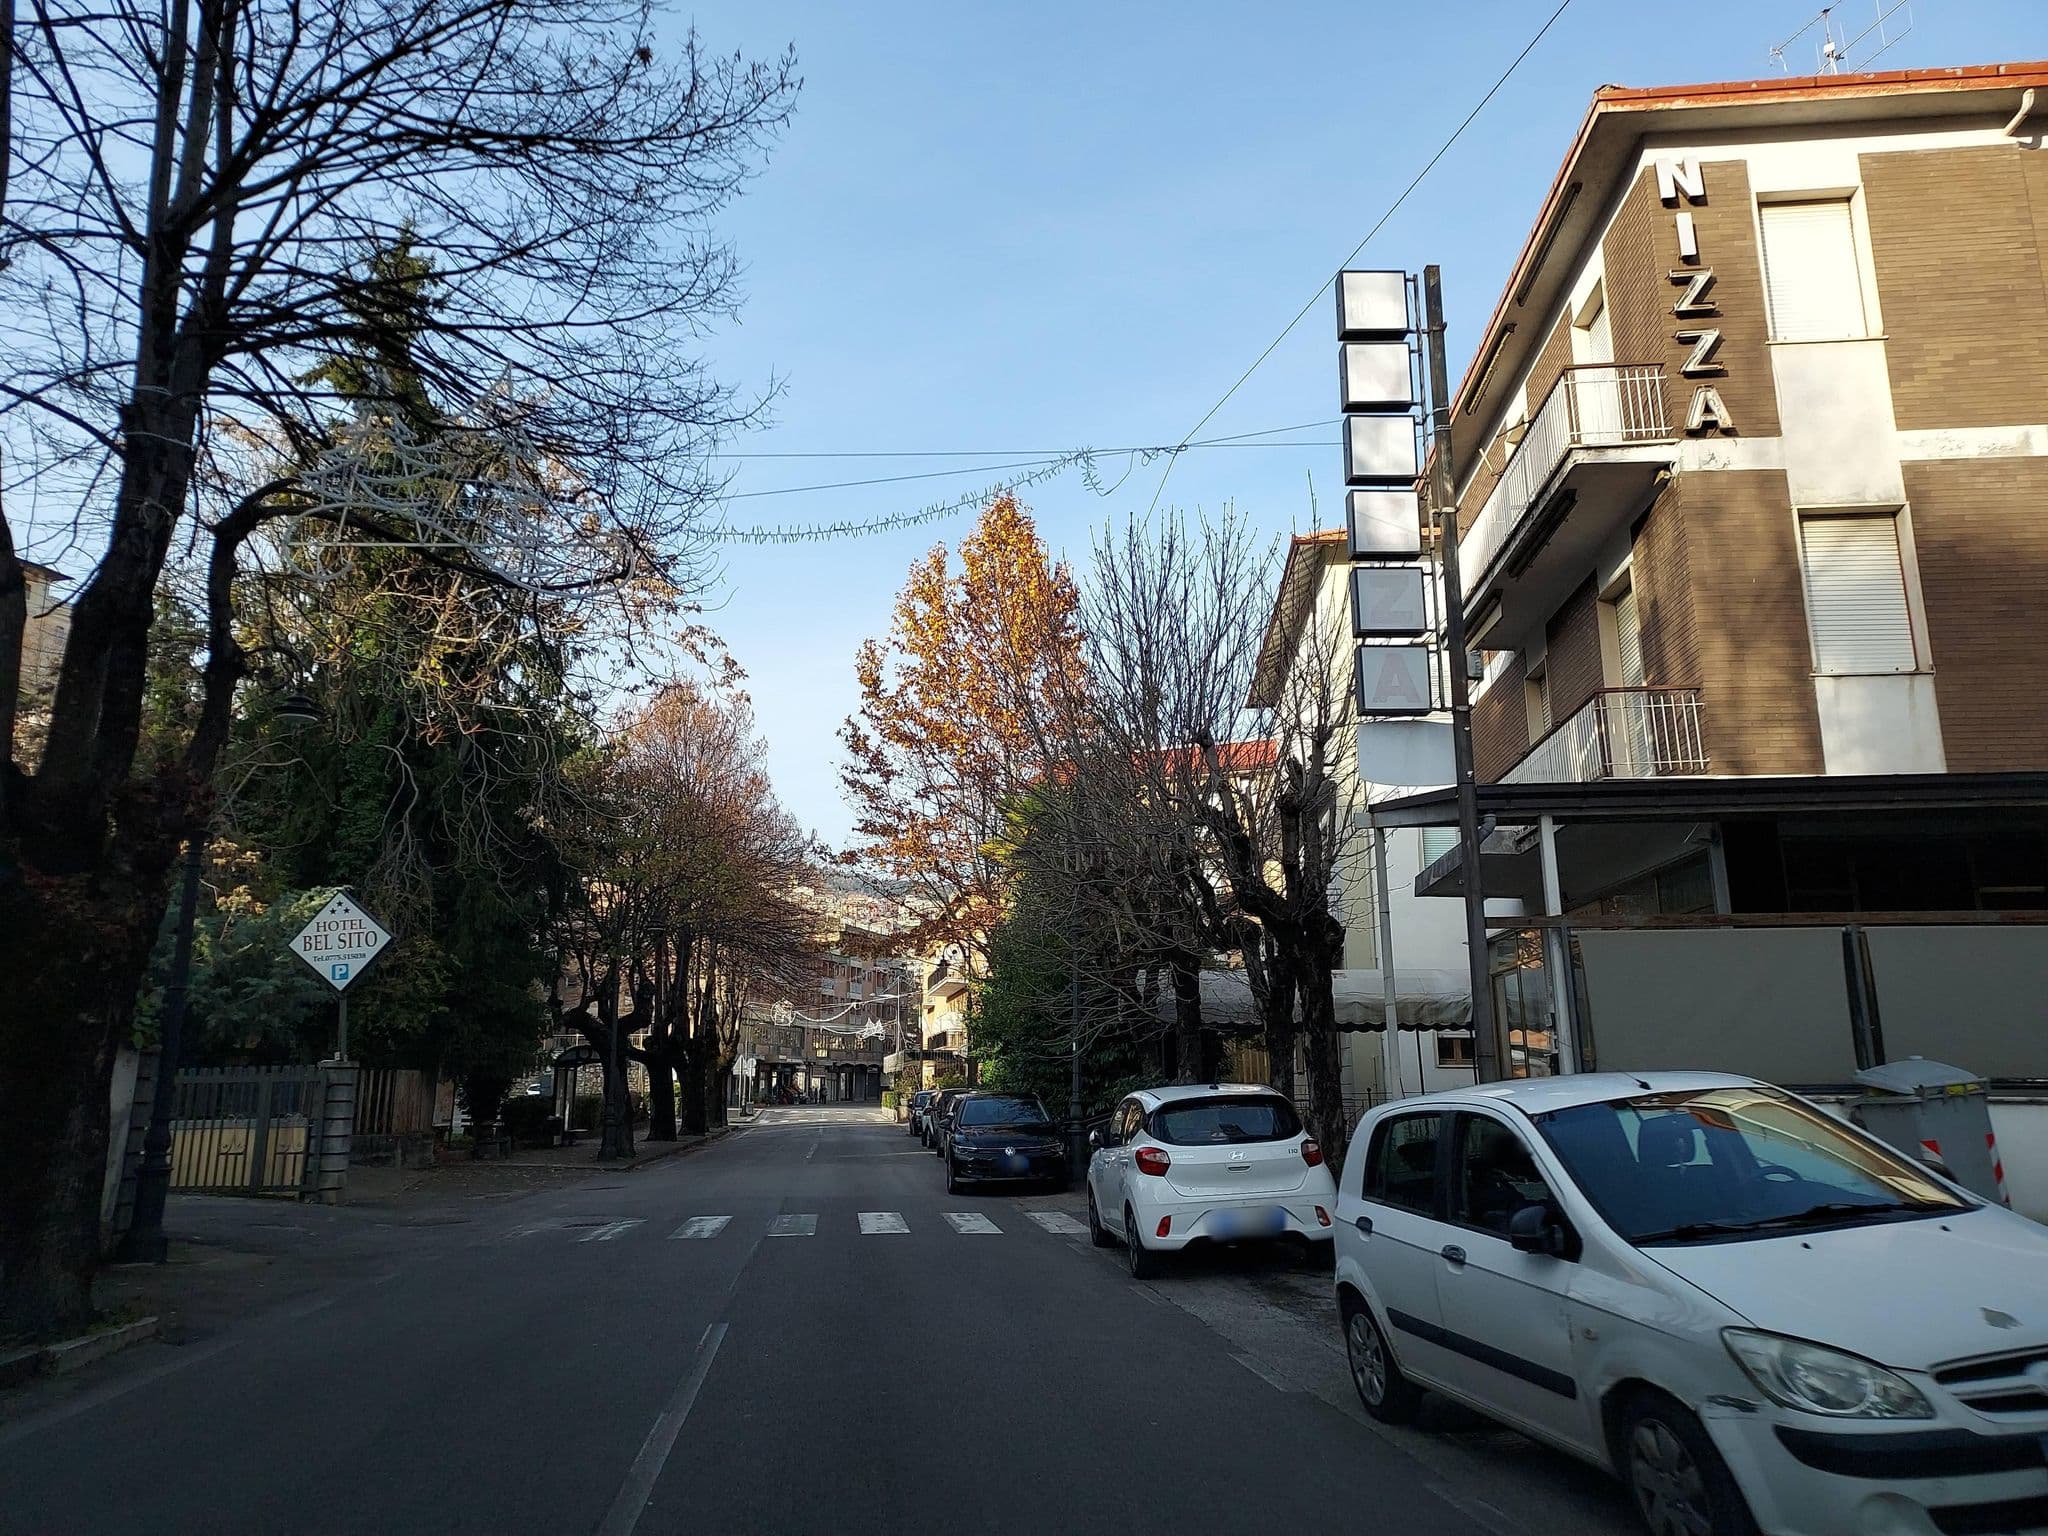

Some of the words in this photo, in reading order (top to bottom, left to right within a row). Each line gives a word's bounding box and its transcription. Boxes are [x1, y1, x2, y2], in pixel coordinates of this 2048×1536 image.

[1655, 157, 1735, 430] NIZZA
[316, 920, 366, 932] HOTEL
[303, 935, 332, 951] BEL
[338, 931, 378, 949] SITO
